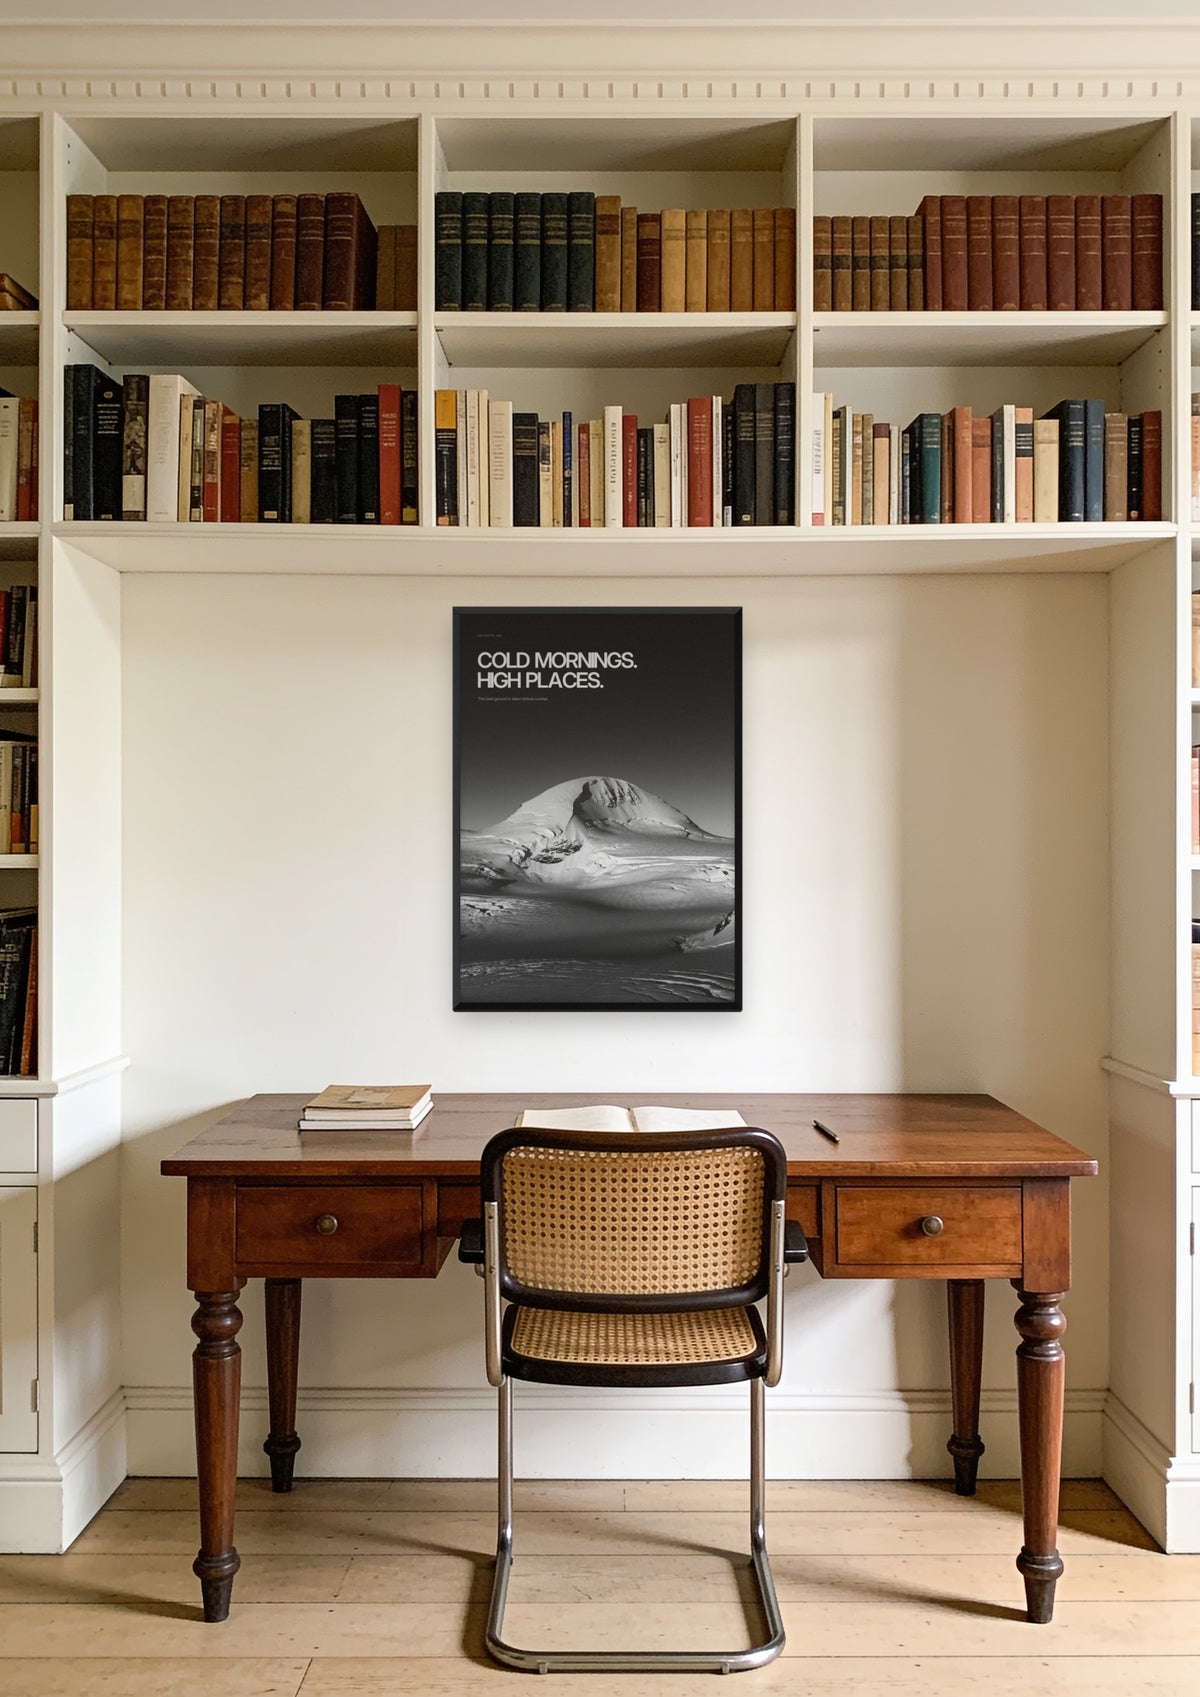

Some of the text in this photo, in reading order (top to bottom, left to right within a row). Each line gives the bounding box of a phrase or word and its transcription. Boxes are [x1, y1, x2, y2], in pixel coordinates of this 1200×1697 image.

[477, 652, 637, 668] COLD MORNINGS.
[477, 672, 604, 688] HIGH PLACES.
